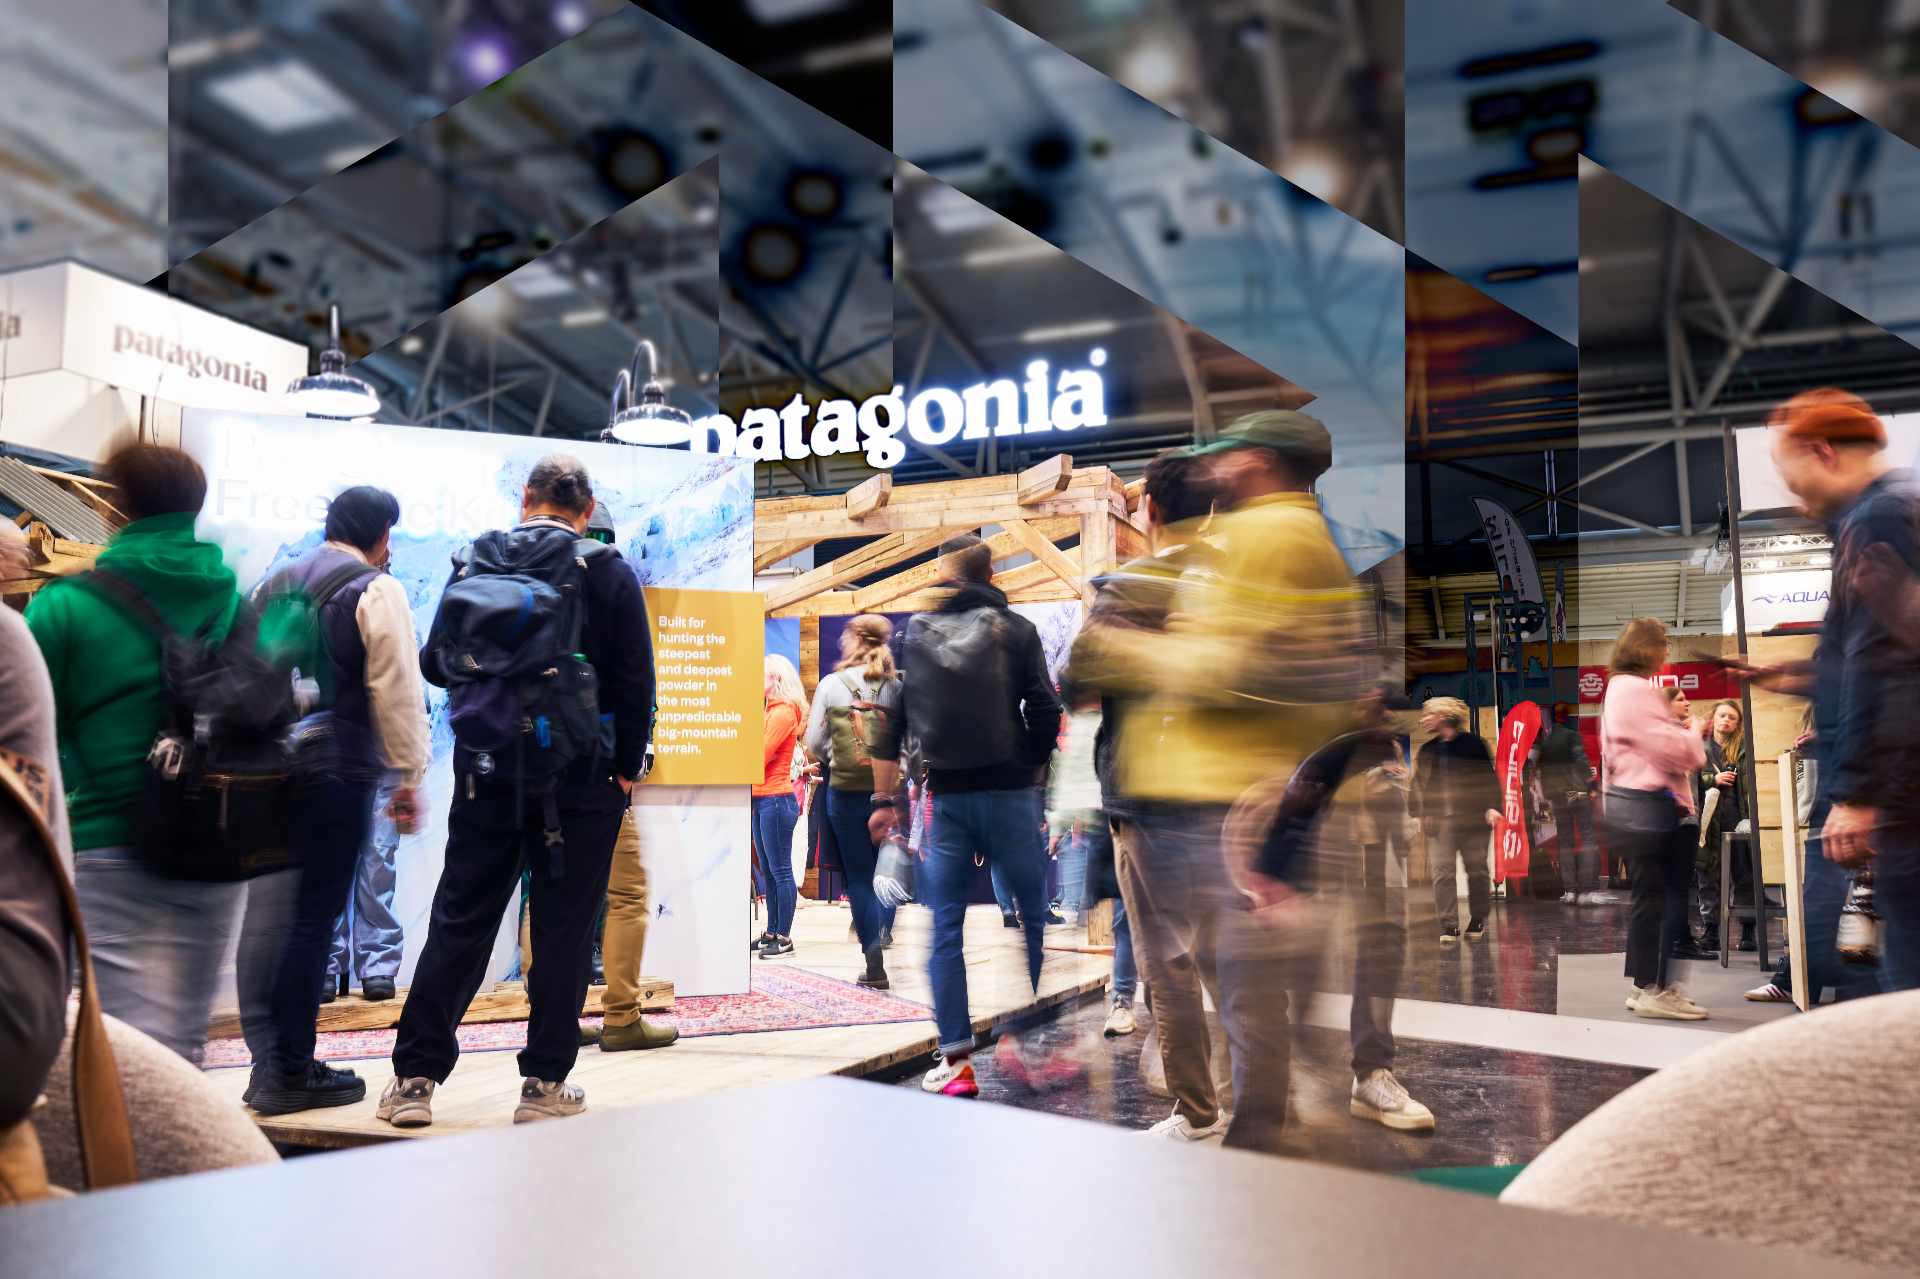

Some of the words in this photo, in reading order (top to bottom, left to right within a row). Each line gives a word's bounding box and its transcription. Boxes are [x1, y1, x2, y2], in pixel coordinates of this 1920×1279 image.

[113, 324, 269, 392] patagonia
[692, 359, 1108, 469] patagonia
[1779, 590, 1830, 603] AQUA
[658, 616, 686, 628] Built
[688, 617, 706, 628] for
[658, 632, 704, 646] hunting
[706, 633, 725, 645] the
[658, 648, 710, 661] steepest
[658, 664, 681, 675] and
[684, 664, 732, 677] deepest
[658, 679, 704, 692] powder
[706, 680, 717, 691] in
[658, 695, 678, 706] the
[681, 696, 710, 707] most
[658, 711, 742, 725] unpredictable
[658, 726, 738, 740] big-mountain
[658, 742, 701, 754] terrain.
